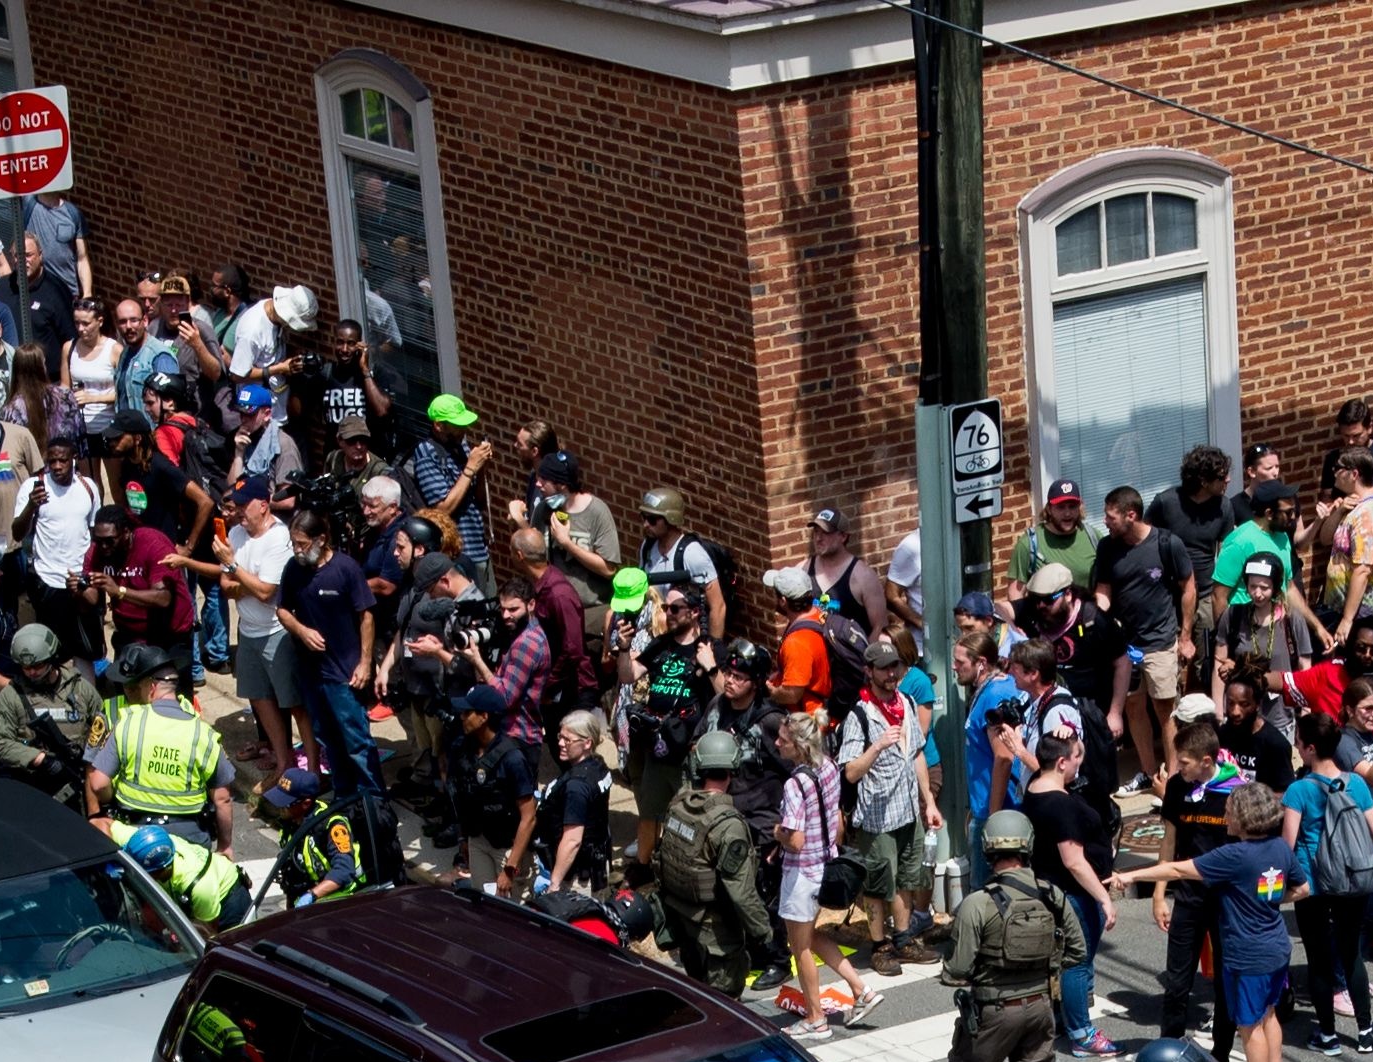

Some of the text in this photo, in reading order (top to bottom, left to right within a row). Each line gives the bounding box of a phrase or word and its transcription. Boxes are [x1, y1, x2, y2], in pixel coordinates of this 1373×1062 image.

[19, 111, 50, 129] NOT
[0, 154, 49, 175] ENTER
[323, 388, 365, 407] FREE
[963, 423, 990, 449] 76
[152, 745, 181, 762] STATE
[147, 761, 181, 777] POLICE
